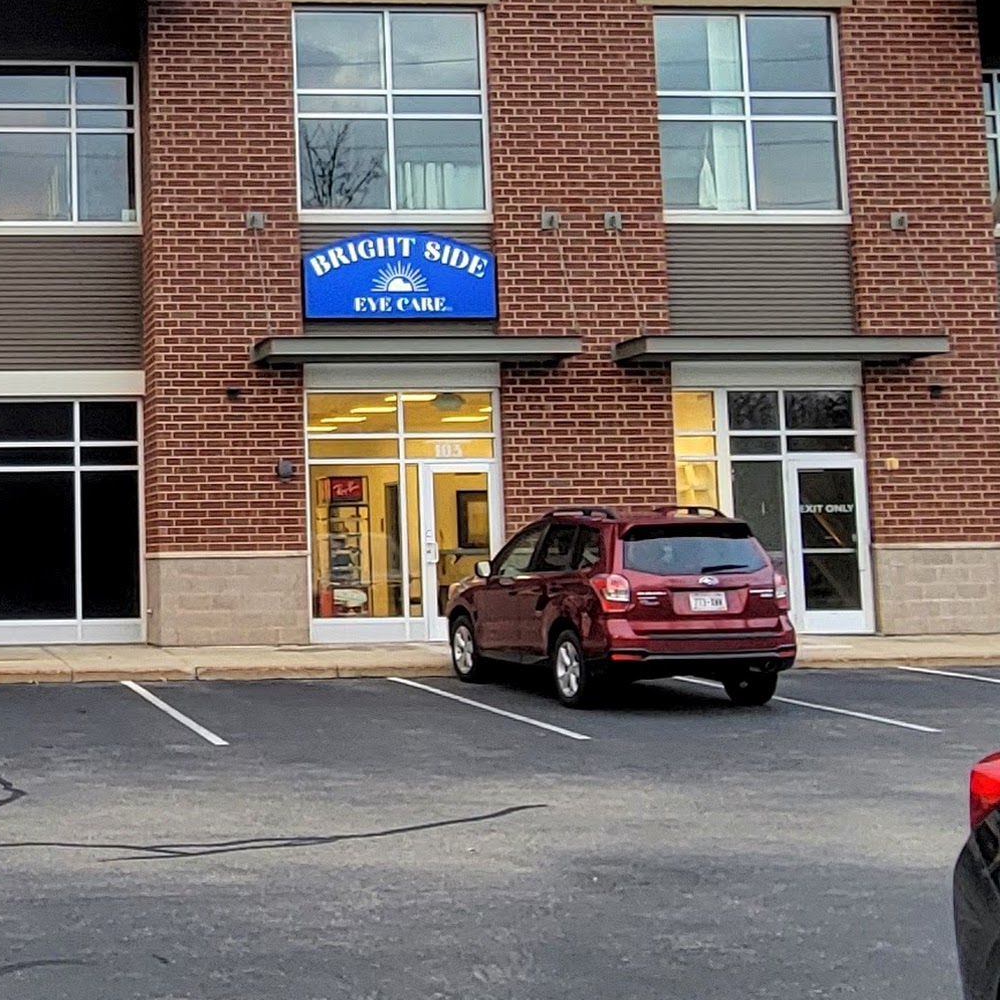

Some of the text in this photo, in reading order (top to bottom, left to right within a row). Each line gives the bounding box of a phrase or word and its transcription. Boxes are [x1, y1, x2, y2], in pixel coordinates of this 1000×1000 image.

[310, 237, 488, 279] BRIGHT SIDE
[354, 297, 447, 312] EYE CARE
[800, 504, 854, 514] EXIT ONLY
